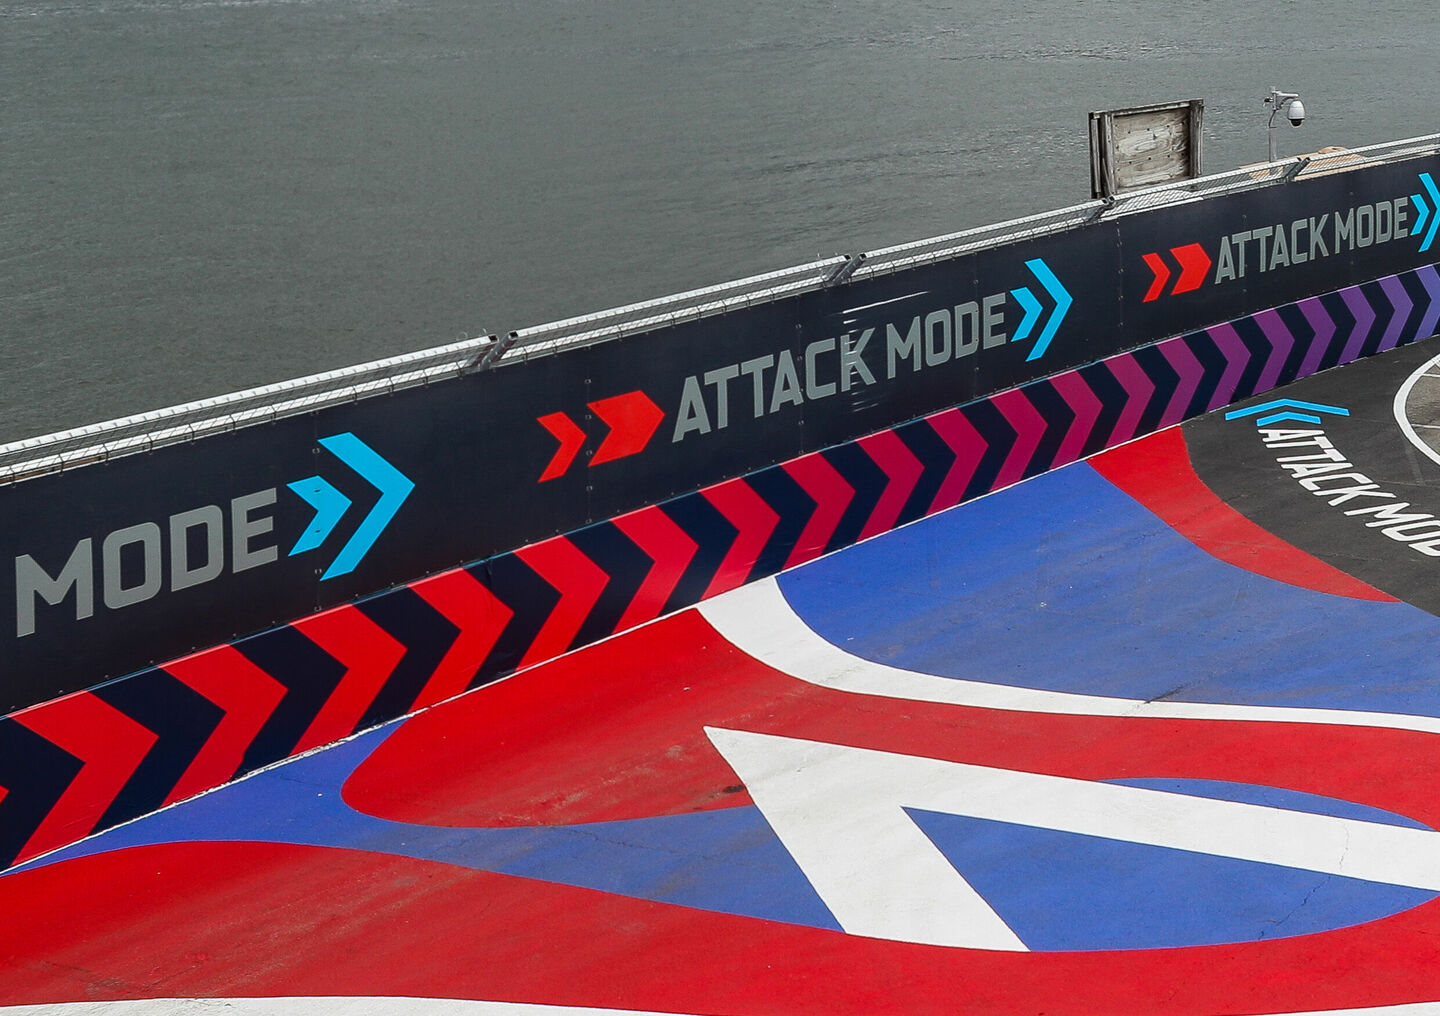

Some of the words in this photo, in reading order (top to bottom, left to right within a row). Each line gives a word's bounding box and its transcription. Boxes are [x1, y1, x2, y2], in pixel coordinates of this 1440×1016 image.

[1214, 214, 1330, 284] ATTACK
[1333, 197, 1409, 249] MODE
[672, 327, 876, 444] ATTACK
[886, 292, 1008, 380] MODE
[1256, 428, 1397, 507] ATTACK
[14, 487, 279, 638] MODE
